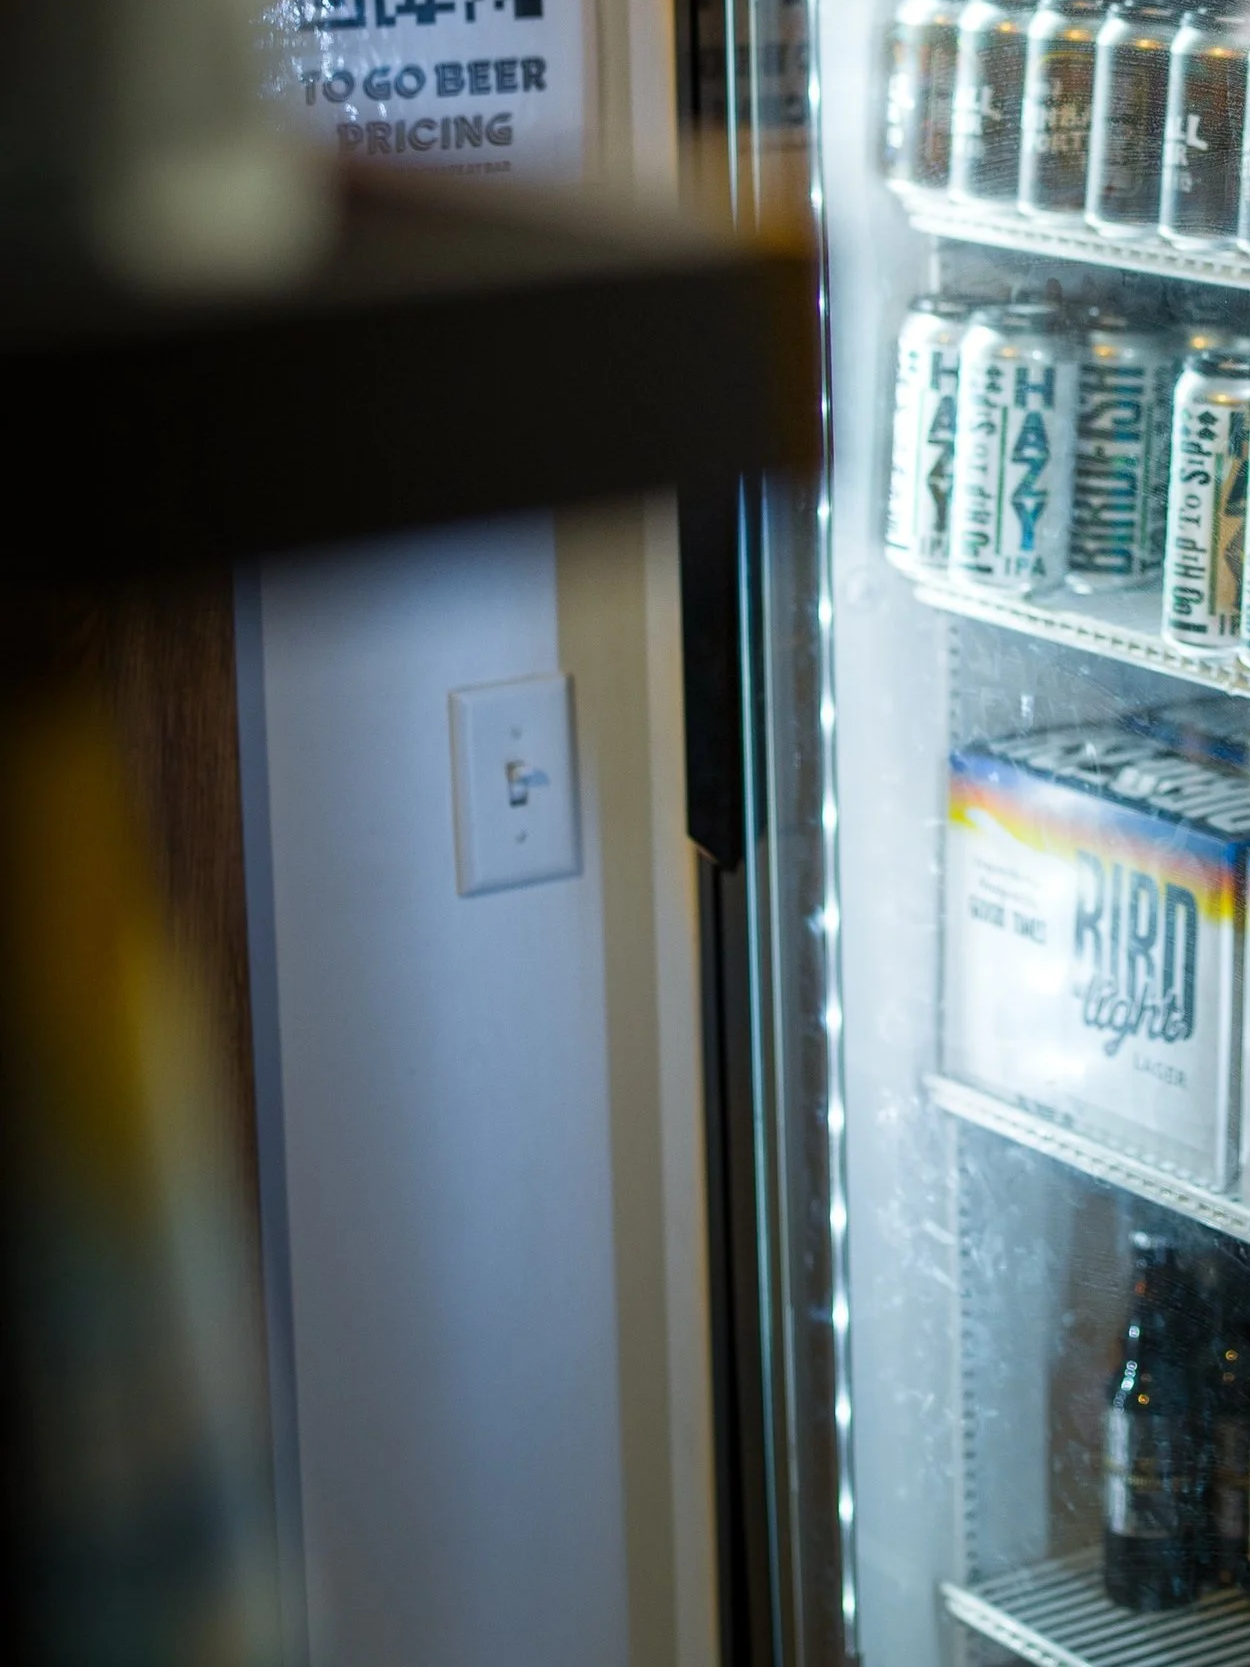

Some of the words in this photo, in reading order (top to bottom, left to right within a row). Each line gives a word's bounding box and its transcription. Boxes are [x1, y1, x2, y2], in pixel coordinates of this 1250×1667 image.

[363, 62, 426, 101] GO
[434, 57, 547, 98] BEER
[336, 112, 513, 155] PRICING
[1010, 367, 1056, 551] HAZY
[1004, 556, 1047, 577] IPA
[1074, 848, 1198, 1042] BIRD
